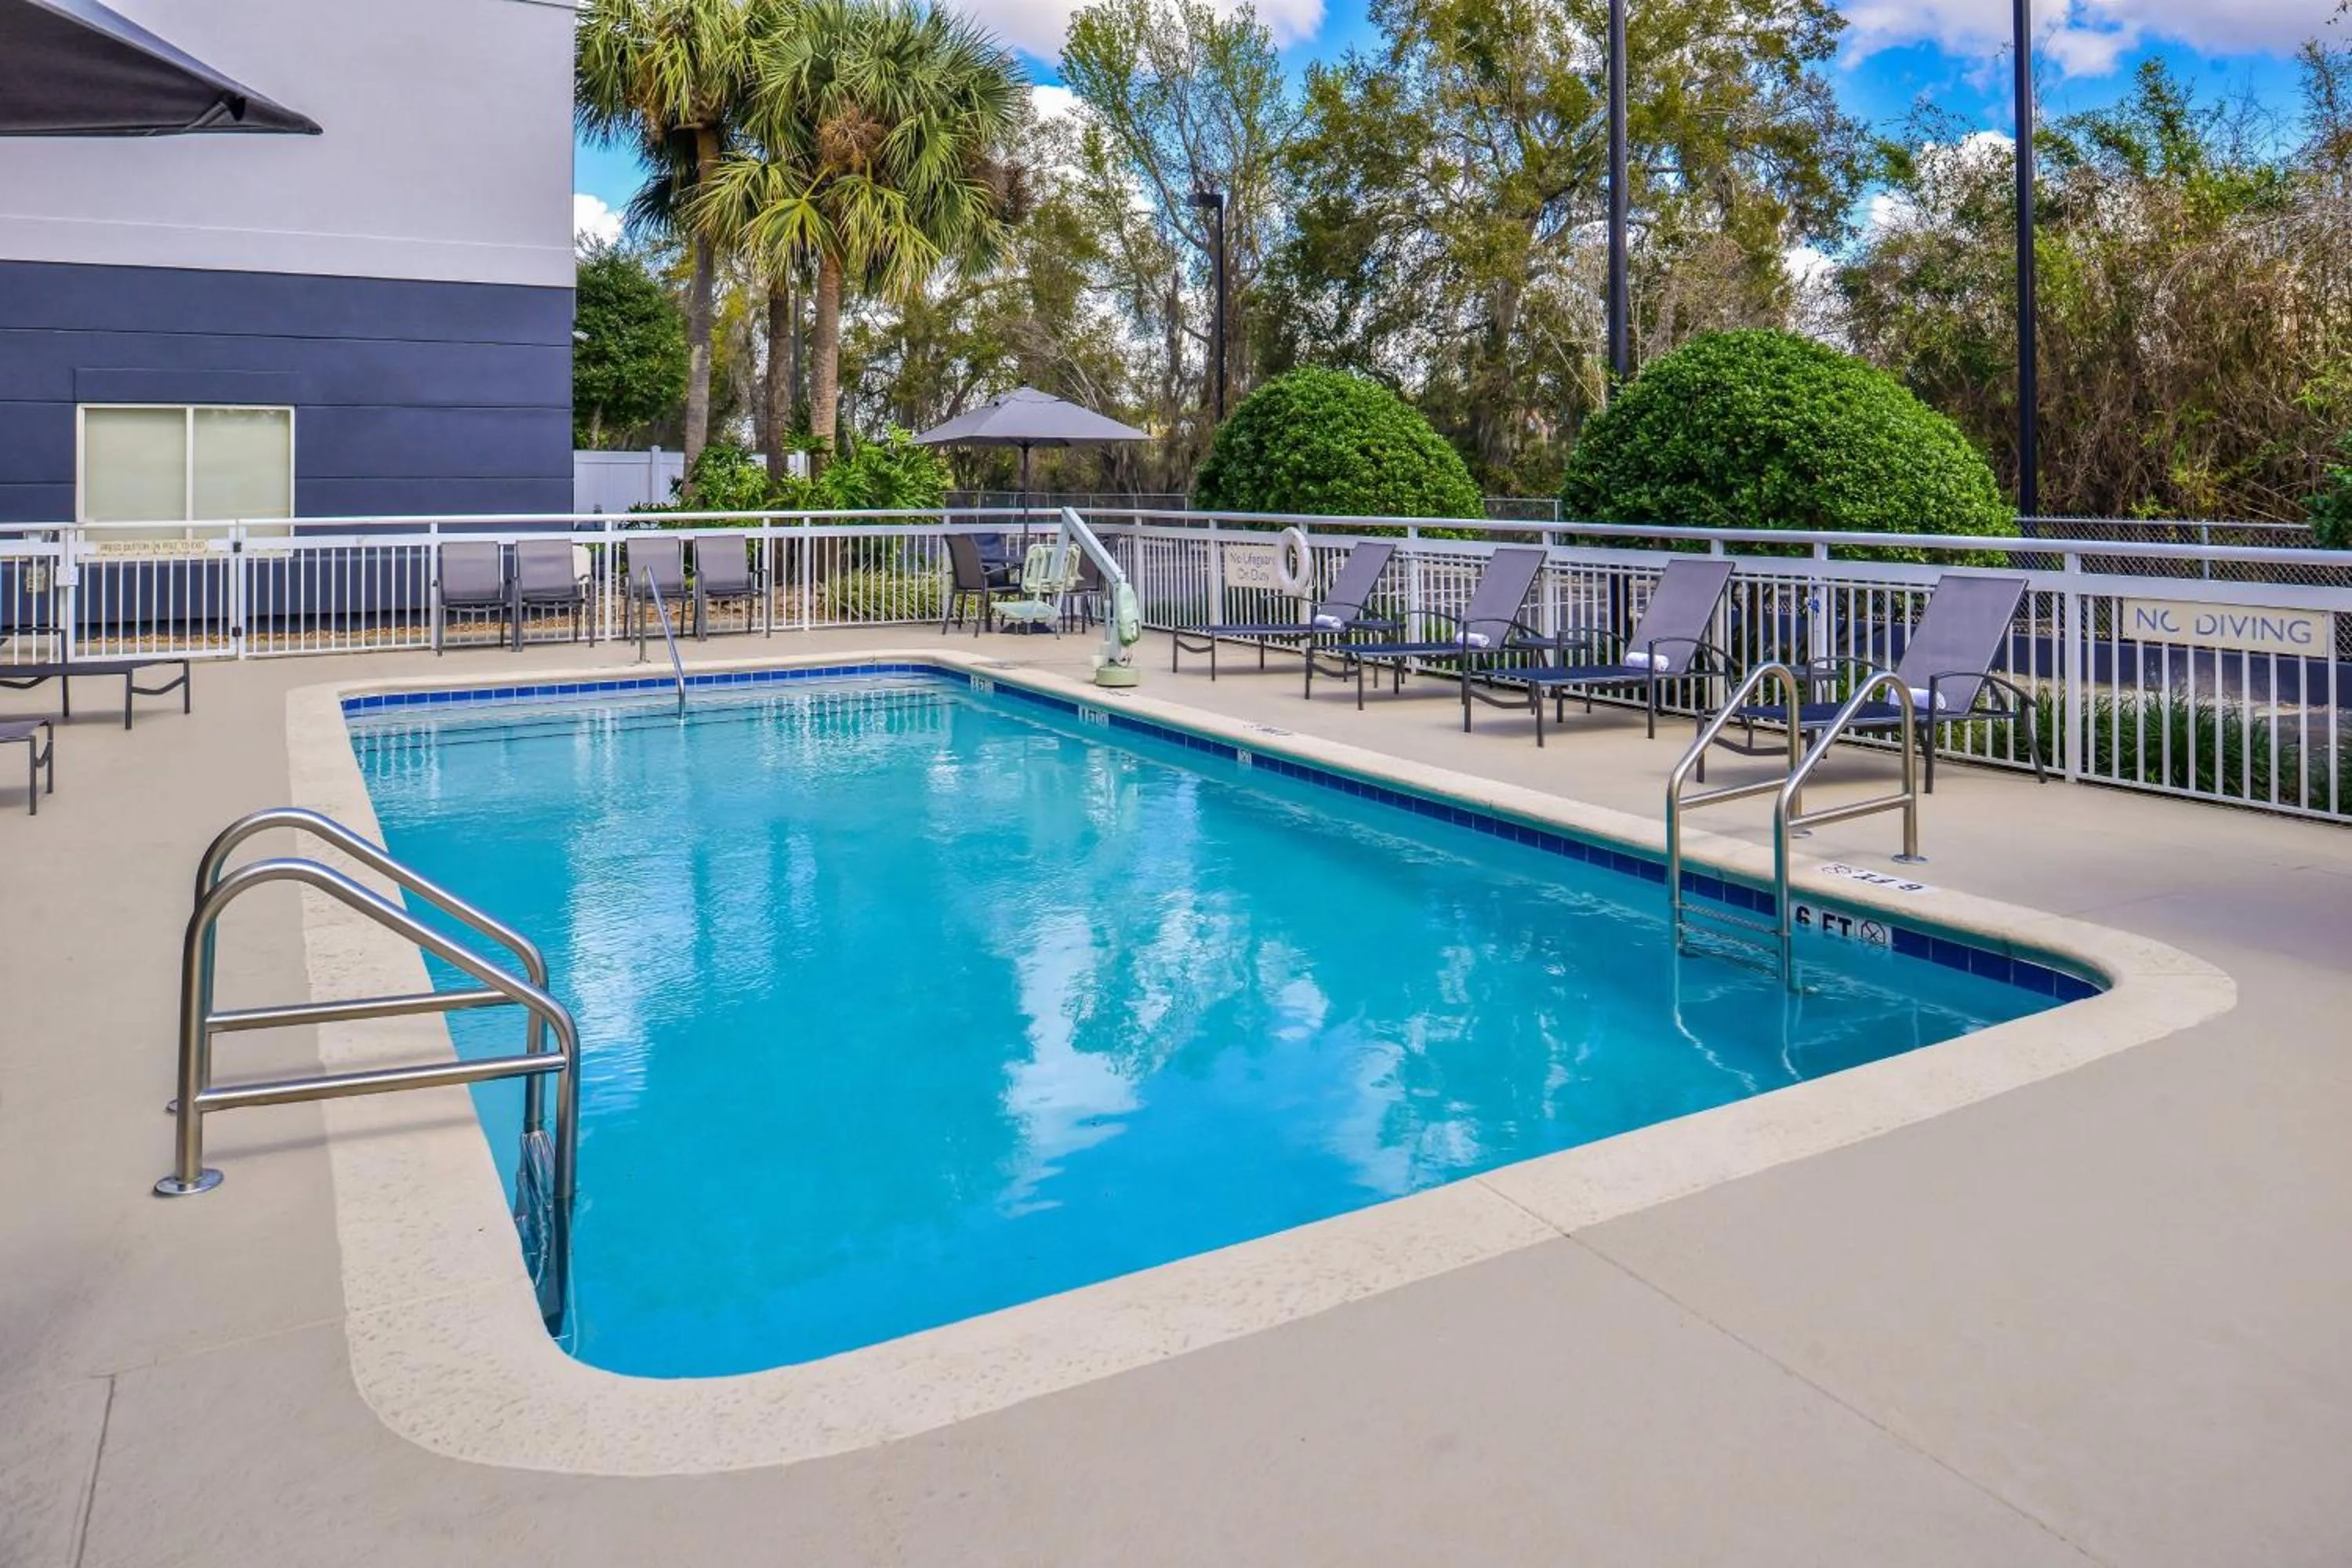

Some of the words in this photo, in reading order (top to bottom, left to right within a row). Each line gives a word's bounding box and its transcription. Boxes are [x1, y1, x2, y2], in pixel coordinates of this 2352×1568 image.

[1230, 551, 1242, 564] No
[1237, 567, 1250, 580] On
[1250, 568, 1270, 582] Duty
[2136, 607, 2180, 633] NO
[2195, 614, 2312, 644] DIVING
[1795, 906, 1811, 925] 6
[1822, 912, 1853, 938] FT
